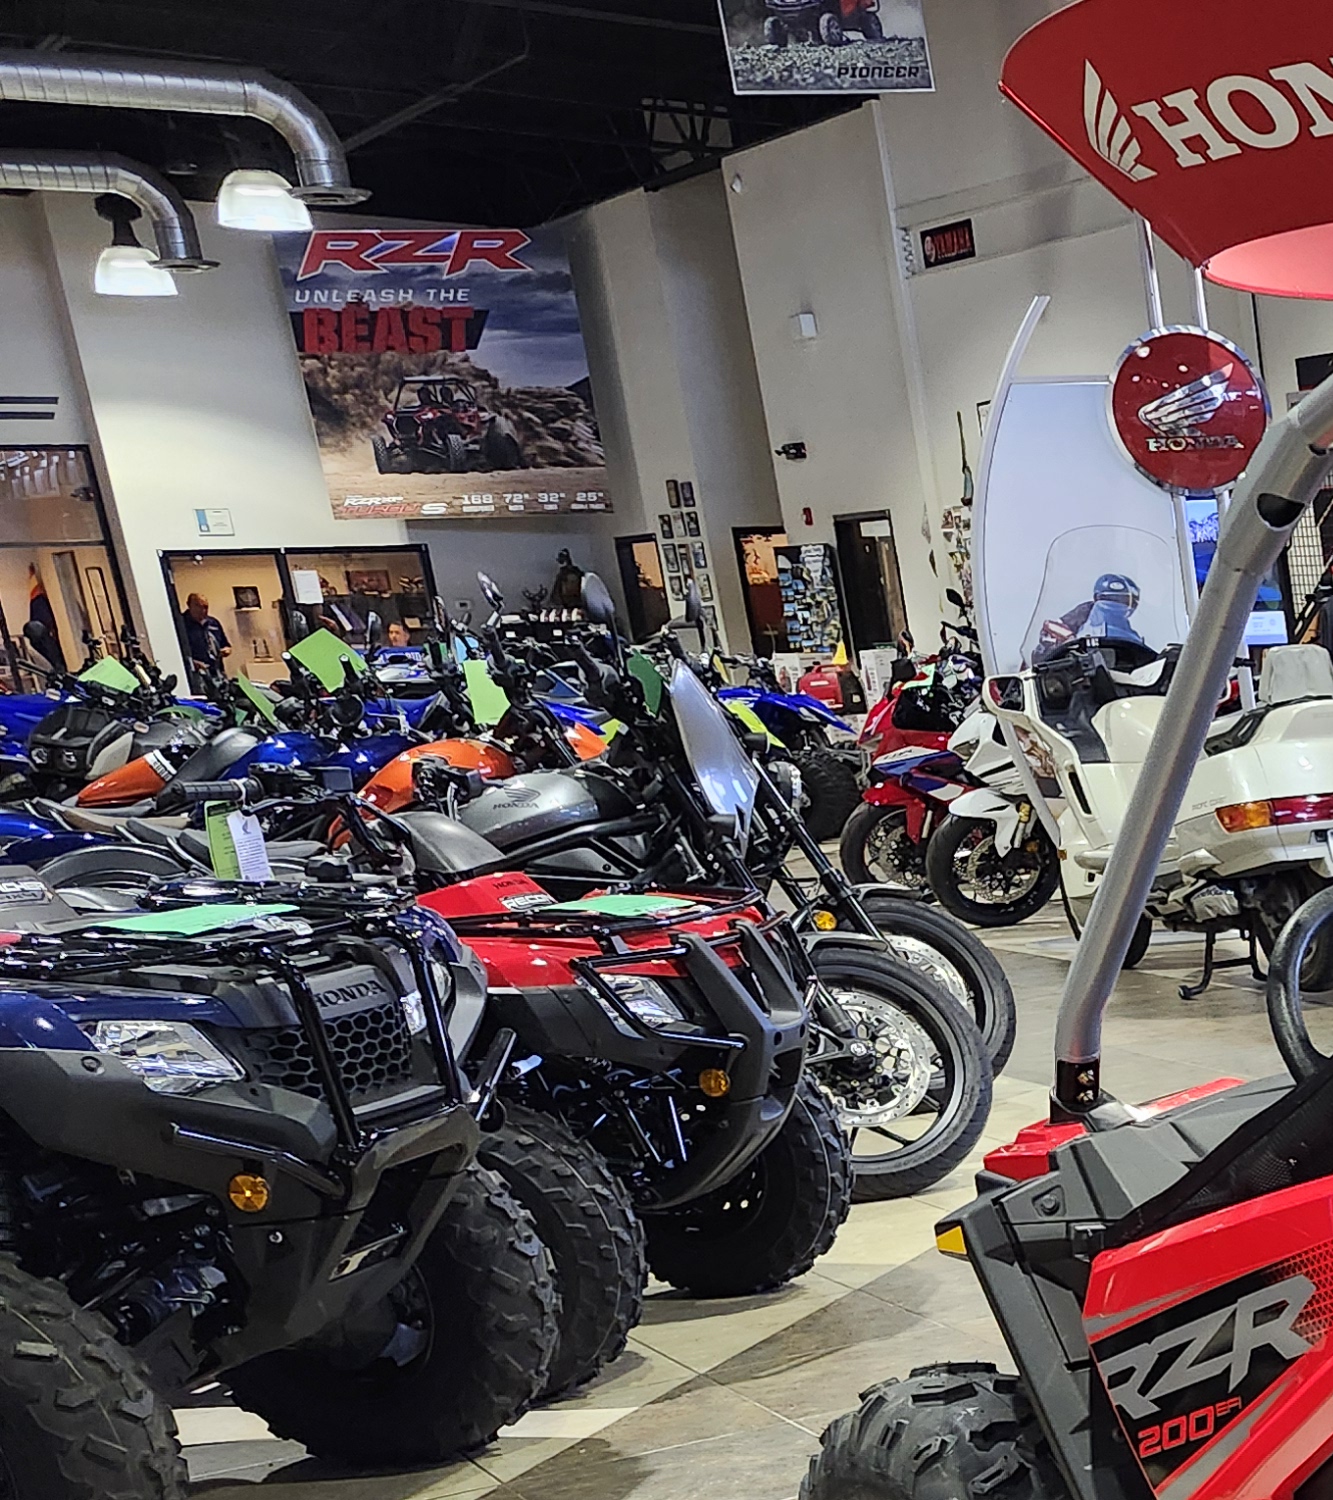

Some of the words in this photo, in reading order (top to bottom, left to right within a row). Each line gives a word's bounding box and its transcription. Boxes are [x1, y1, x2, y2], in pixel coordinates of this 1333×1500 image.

[837, 66, 920, 78] PIONEER
[297, 229, 534, 281] RZR
[295, 288, 414, 303] UNLEASH
[426, 288, 470, 302] THE
[303, 306, 474, 353] BEAST
[1146, 435, 1244, 451] HONDA
[493, 802, 540, 810] HONDA
[1098, 1274, 1317, 1419] RZR
[1138, 1406, 1215, 1458] 200
